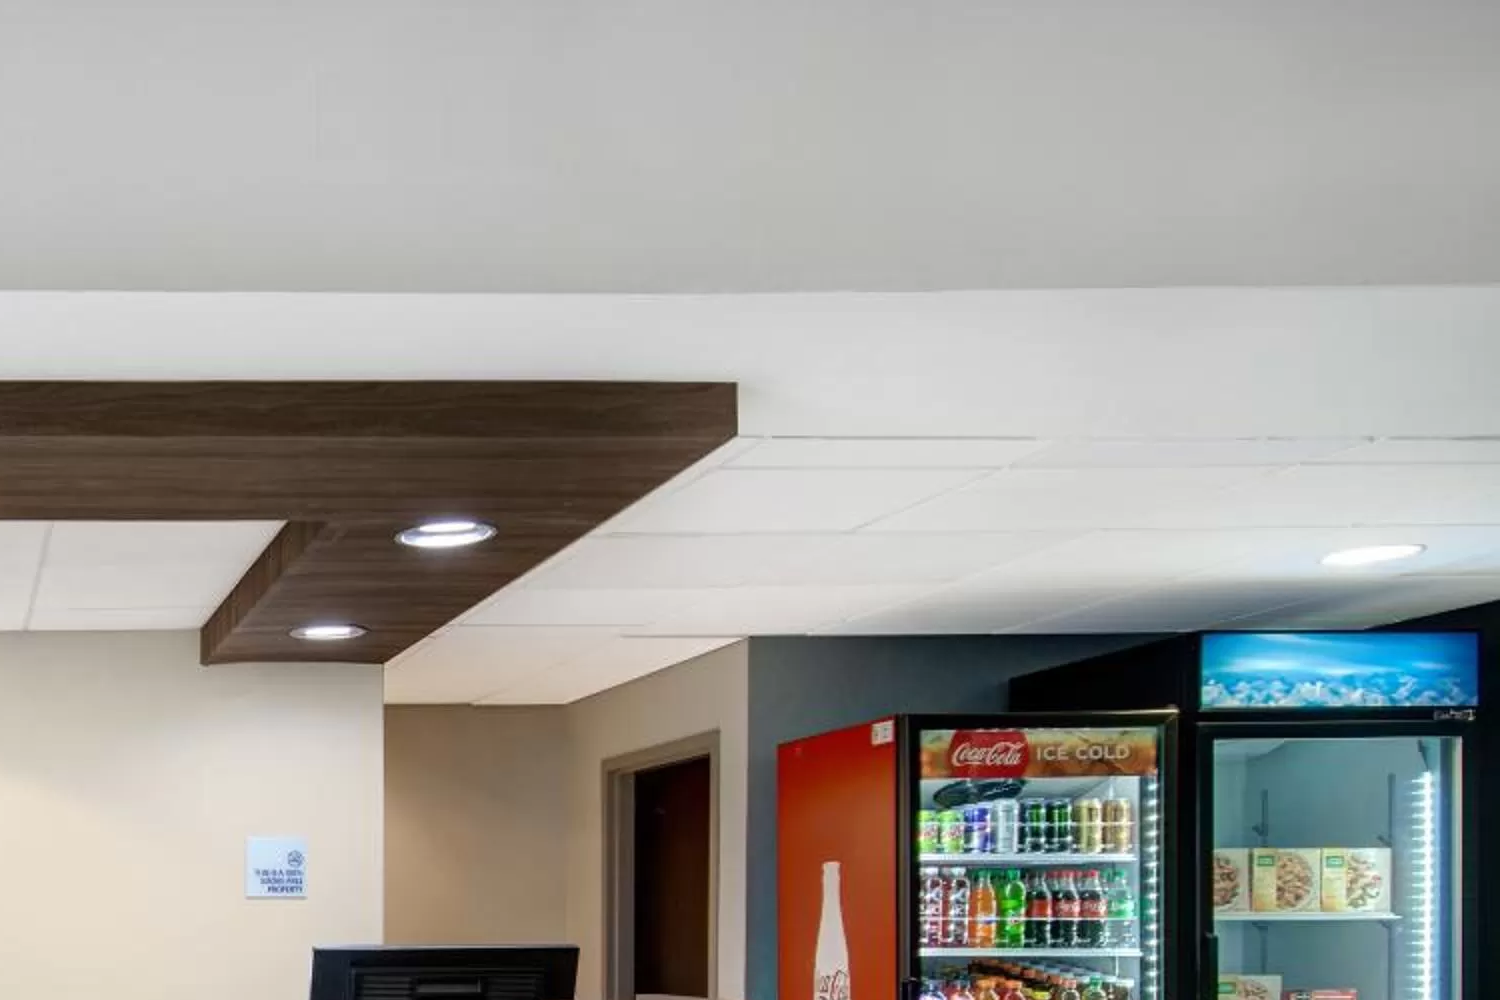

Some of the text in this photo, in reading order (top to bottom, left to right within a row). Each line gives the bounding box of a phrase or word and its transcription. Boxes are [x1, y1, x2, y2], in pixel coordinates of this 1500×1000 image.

[952, 741, 1025, 767] Coca-Cola
[1036, 744, 1131, 761] ICE COLD
